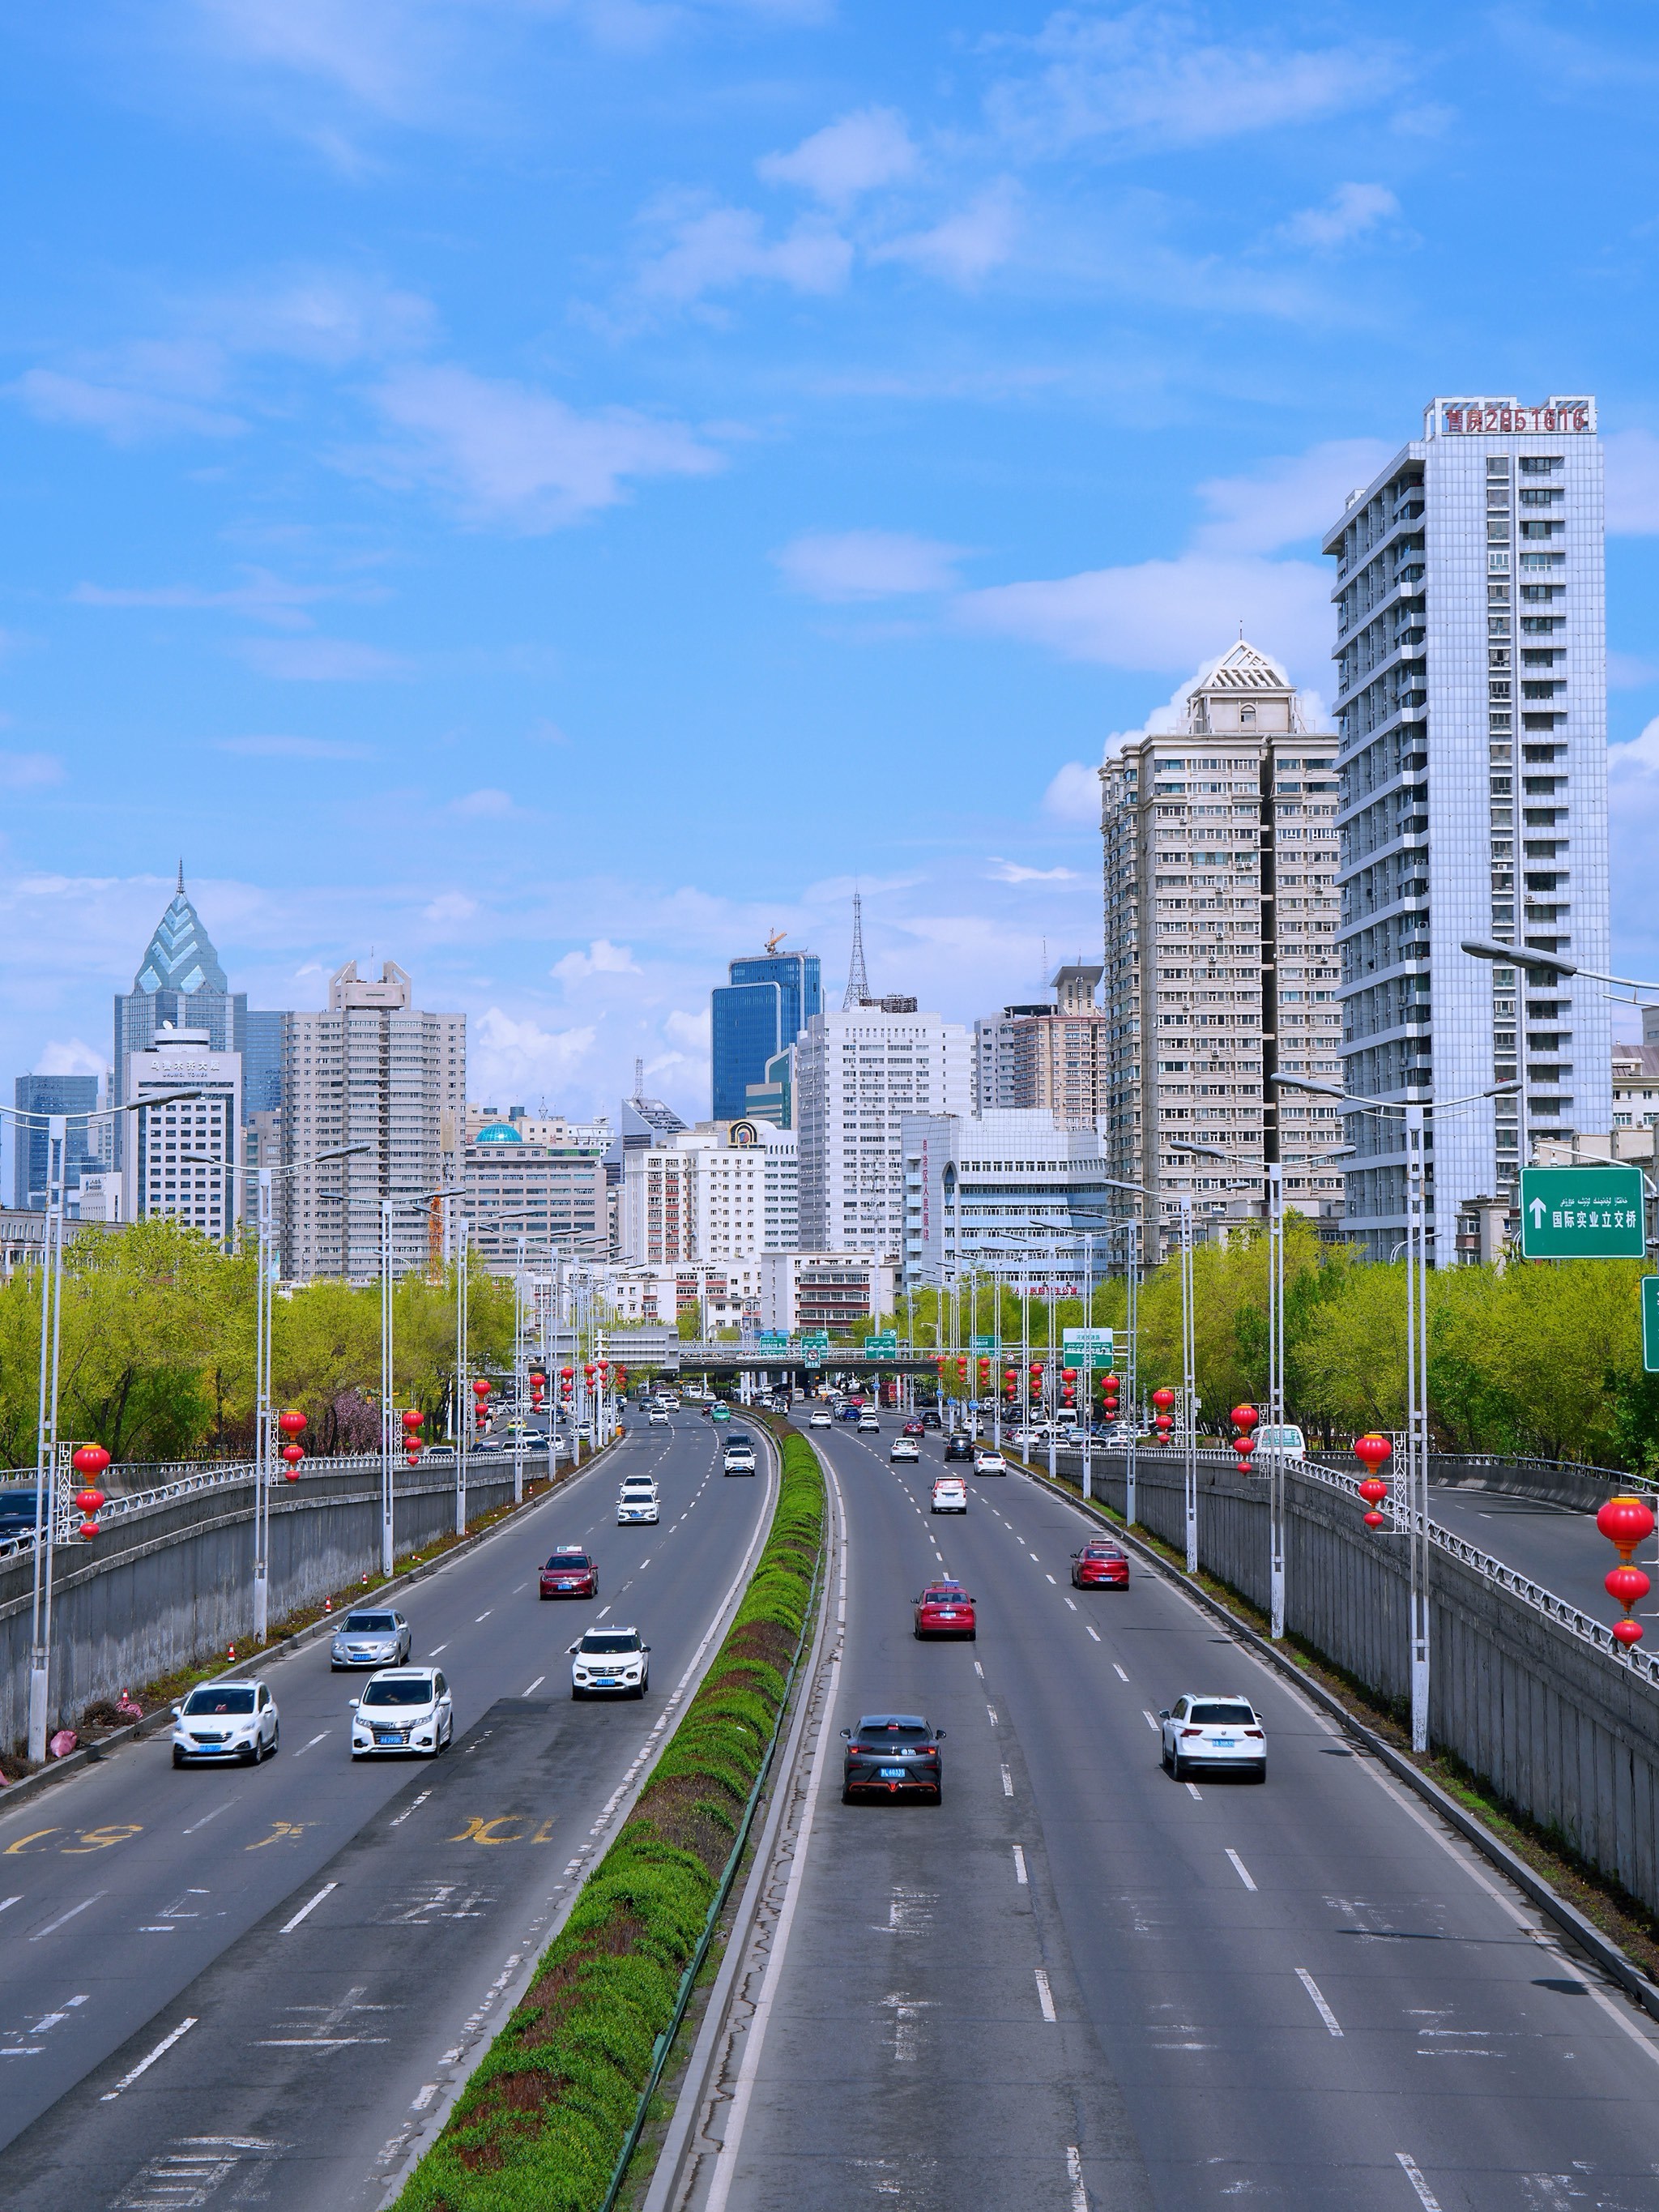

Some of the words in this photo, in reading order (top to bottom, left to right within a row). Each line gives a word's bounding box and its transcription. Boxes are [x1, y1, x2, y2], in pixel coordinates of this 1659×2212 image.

[151, 1060, 220, 1071] 乌鲁木齐大厦
[1552, 1211, 1636, 1228] 国际实业立交桥
